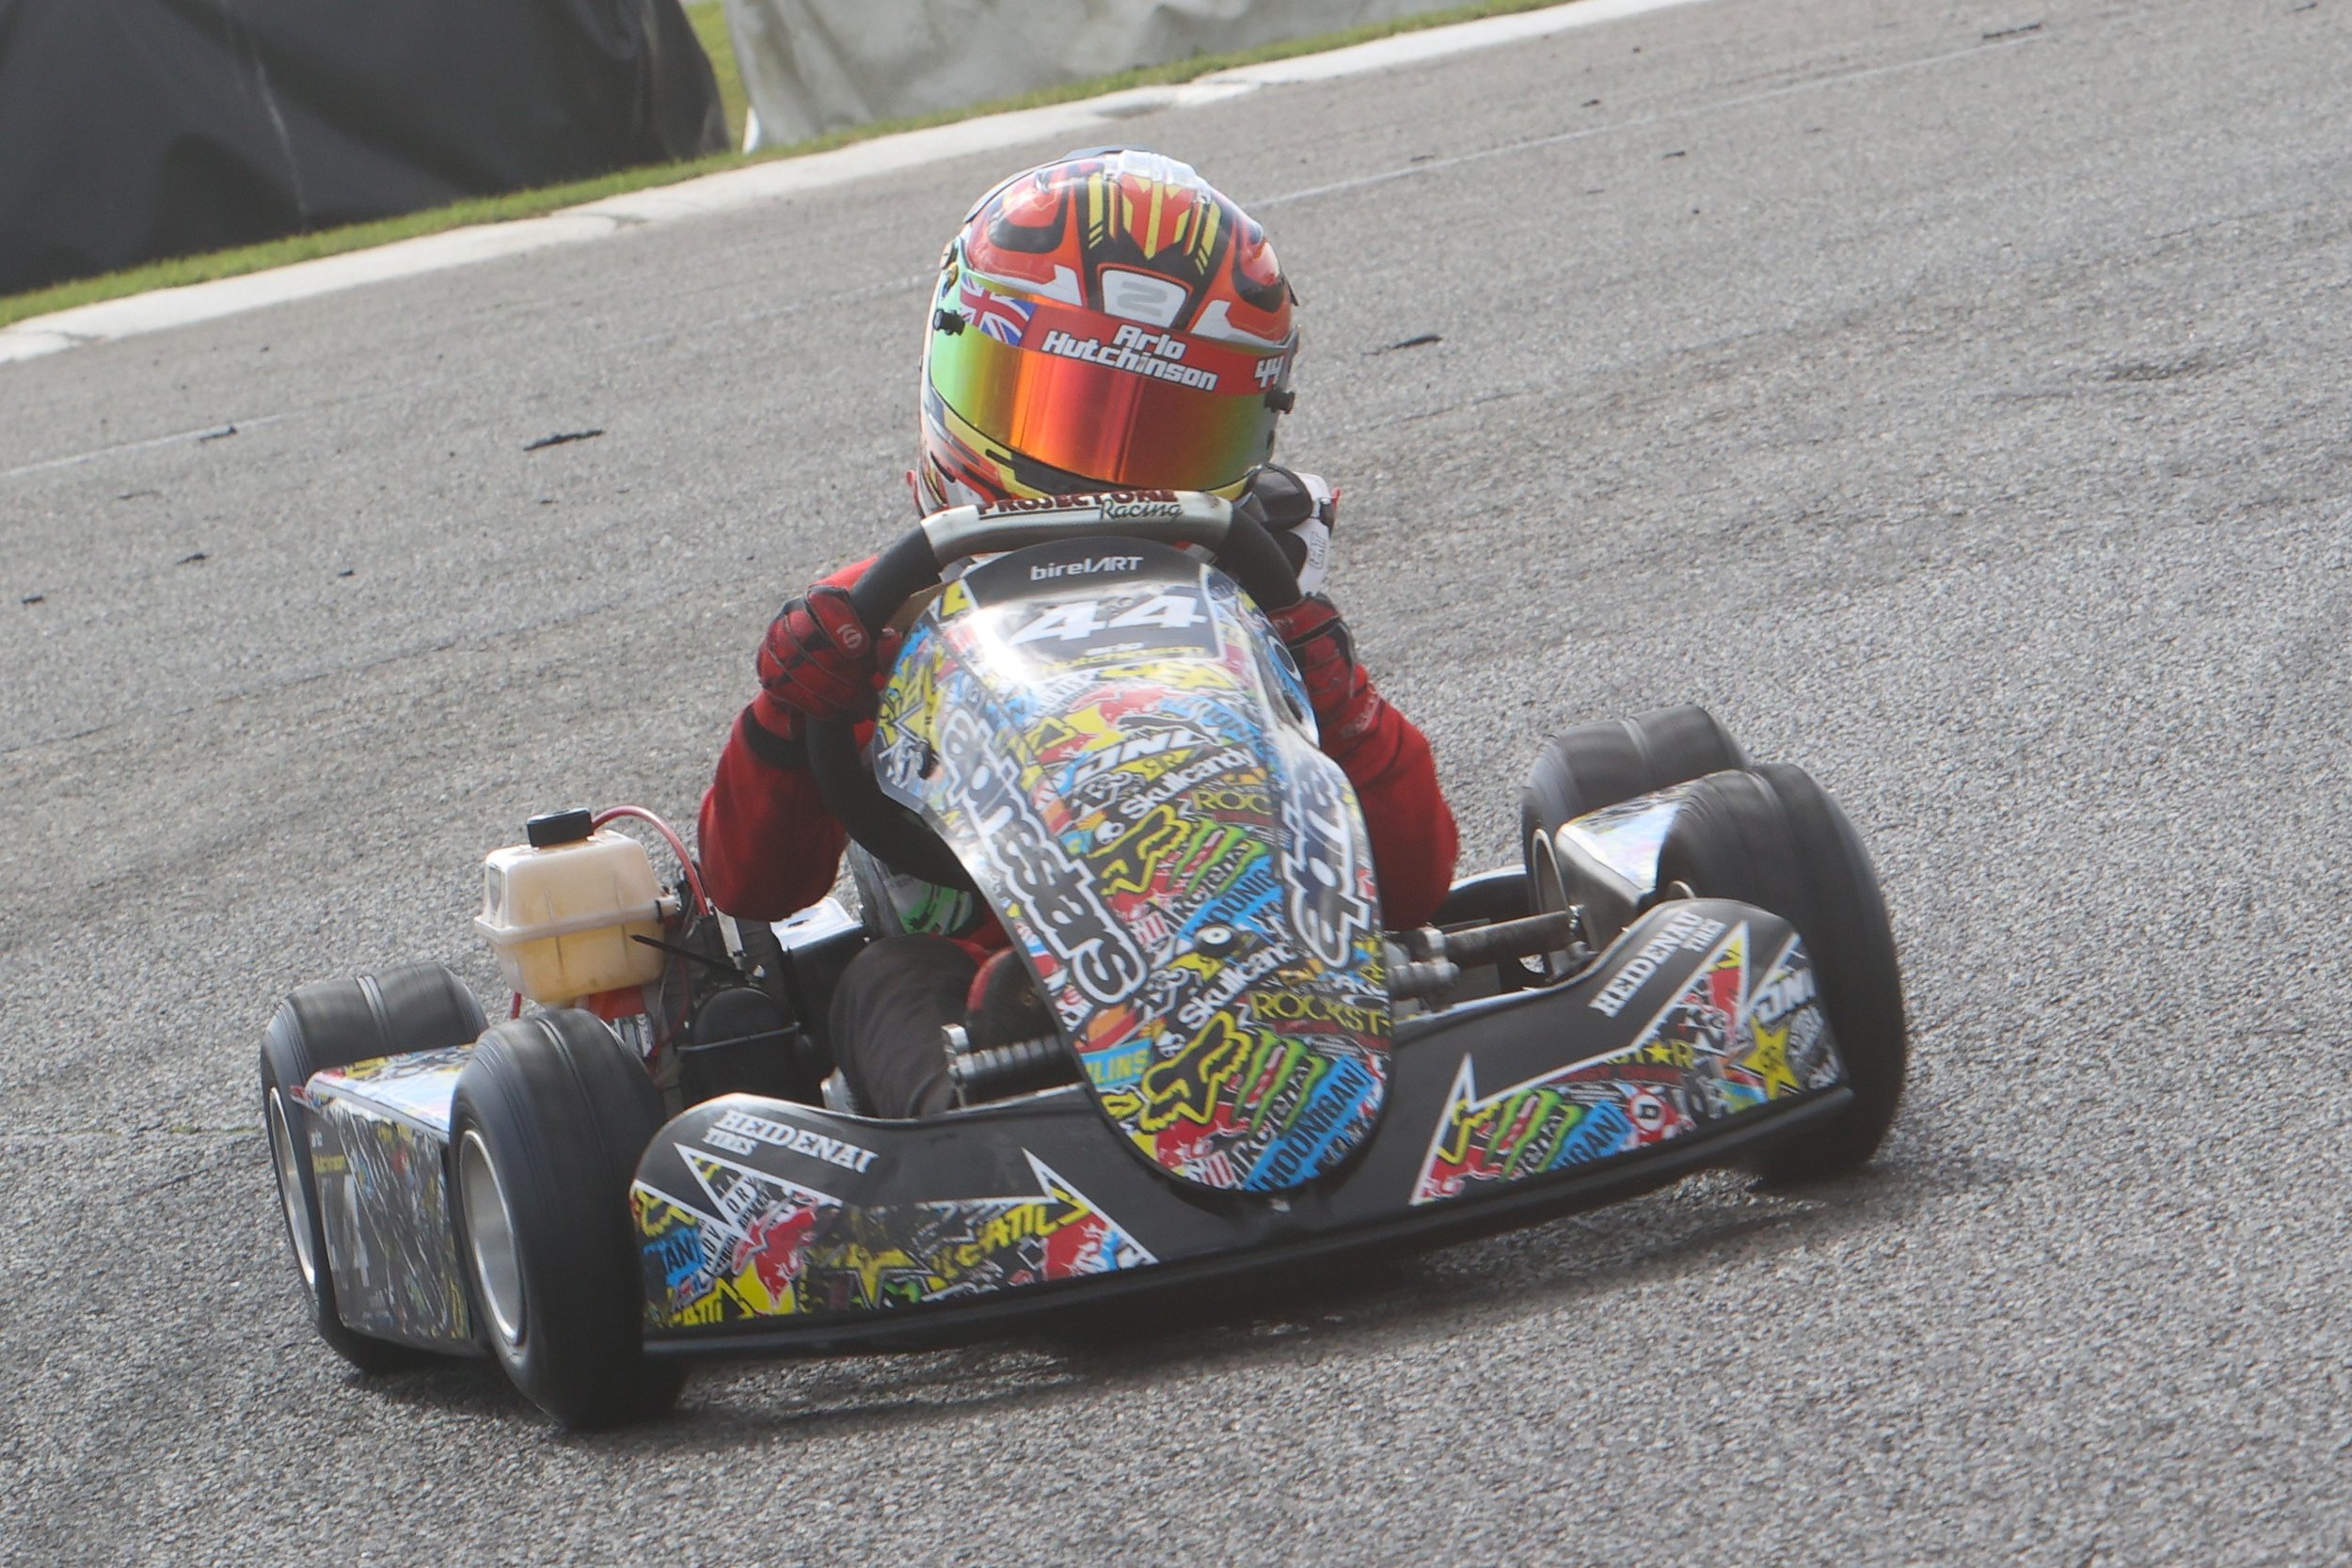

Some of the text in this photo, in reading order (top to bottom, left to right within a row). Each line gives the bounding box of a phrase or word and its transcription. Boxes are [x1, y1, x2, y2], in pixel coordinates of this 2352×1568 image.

[1041, 330, 1219, 391] Hutchinson
[1113, 325, 1186, 360] Arlo
[1254, 355, 1285, 388] 44
[1100, 499, 1183, 519] Racing
[1009, 594, 1208, 646] 44
[1588, 909, 1703, 1019] HEIDENAU
[1248, 991, 1388, 1036] ROCKST
[1086, 1048, 1151, 1084] LINS
